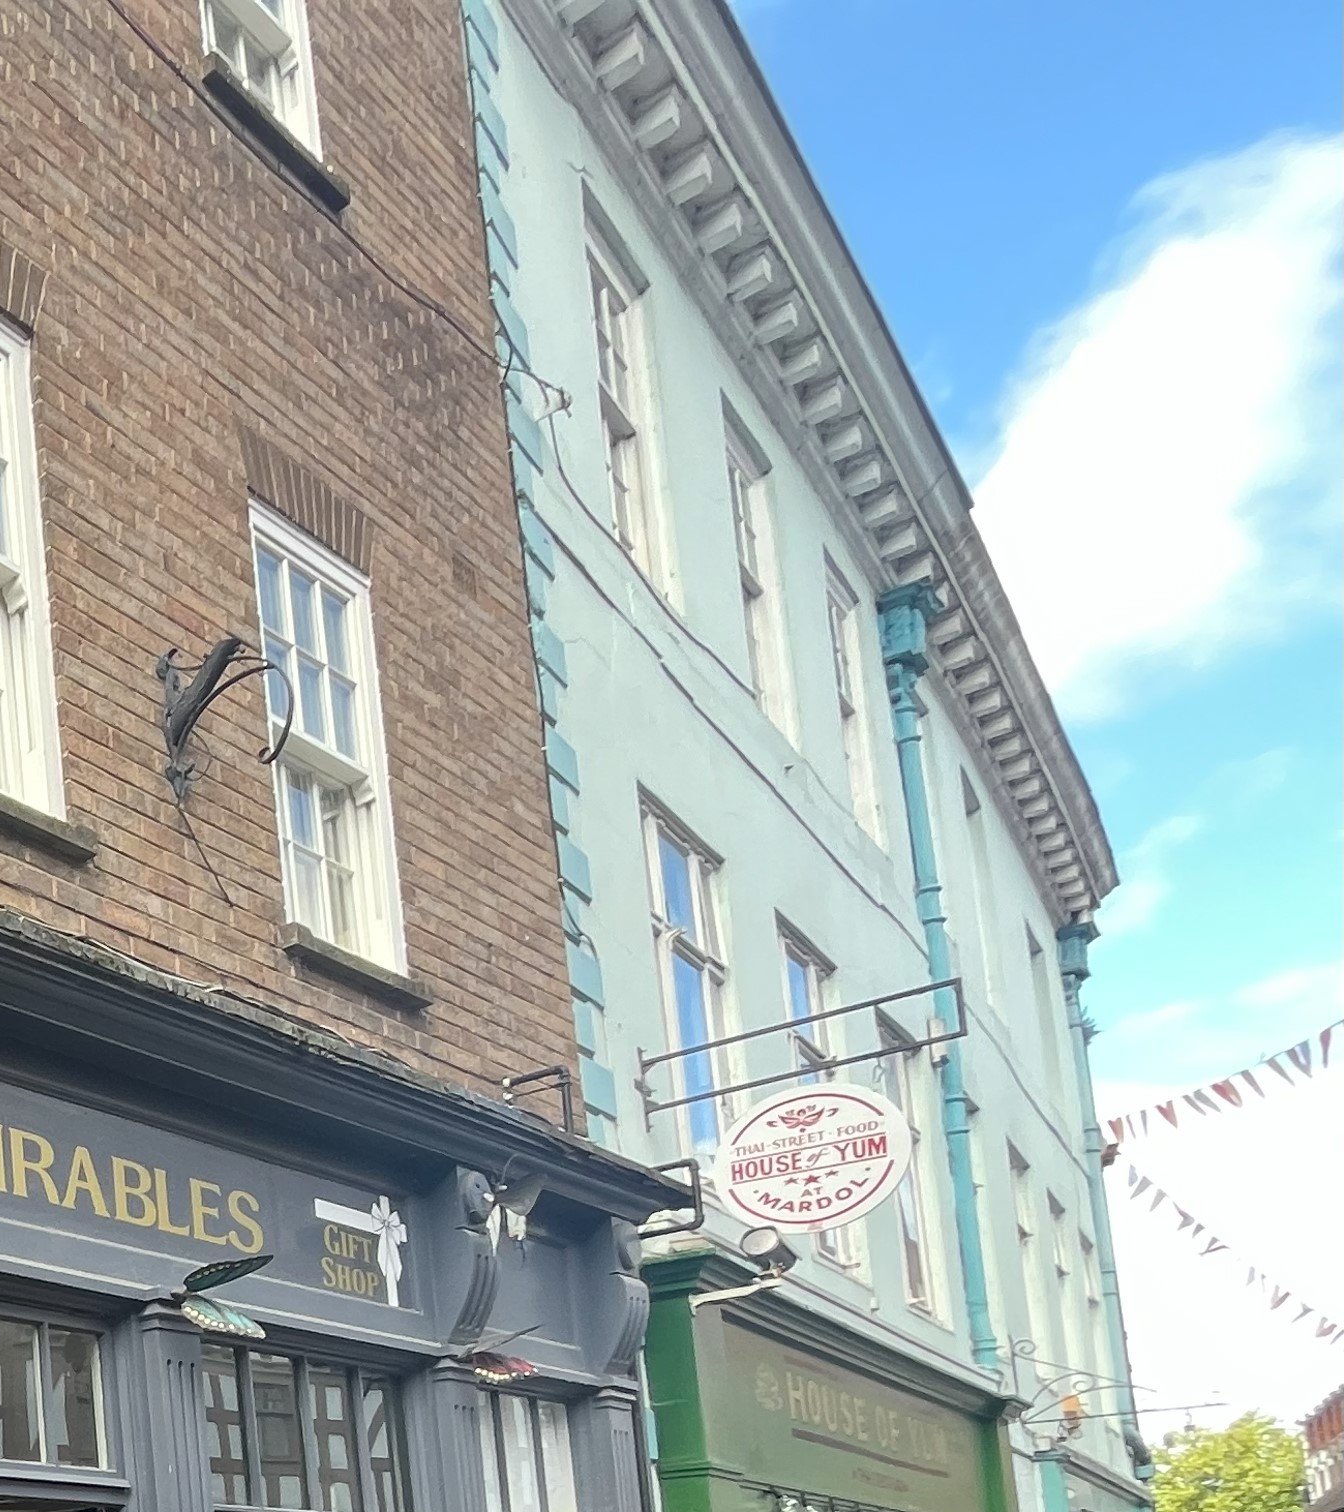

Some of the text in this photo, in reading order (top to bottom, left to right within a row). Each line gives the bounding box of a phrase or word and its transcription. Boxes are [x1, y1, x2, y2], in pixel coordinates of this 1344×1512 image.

[836, 1120, 880, 1138] FOOD
[730, 1151, 803, 1182] HOUSE
[833, 1134, 889, 1162] YUM
[757, 1176, 871, 1213] MARDOL
[800, 1186, 825, 1199] AT
[323, 1224, 373, 1264] GIFT
[320, 1256, 380, 1297] SHOP
[785, 1371, 869, 1442] HOUSE
[874, 1405, 901, 1453] OF
